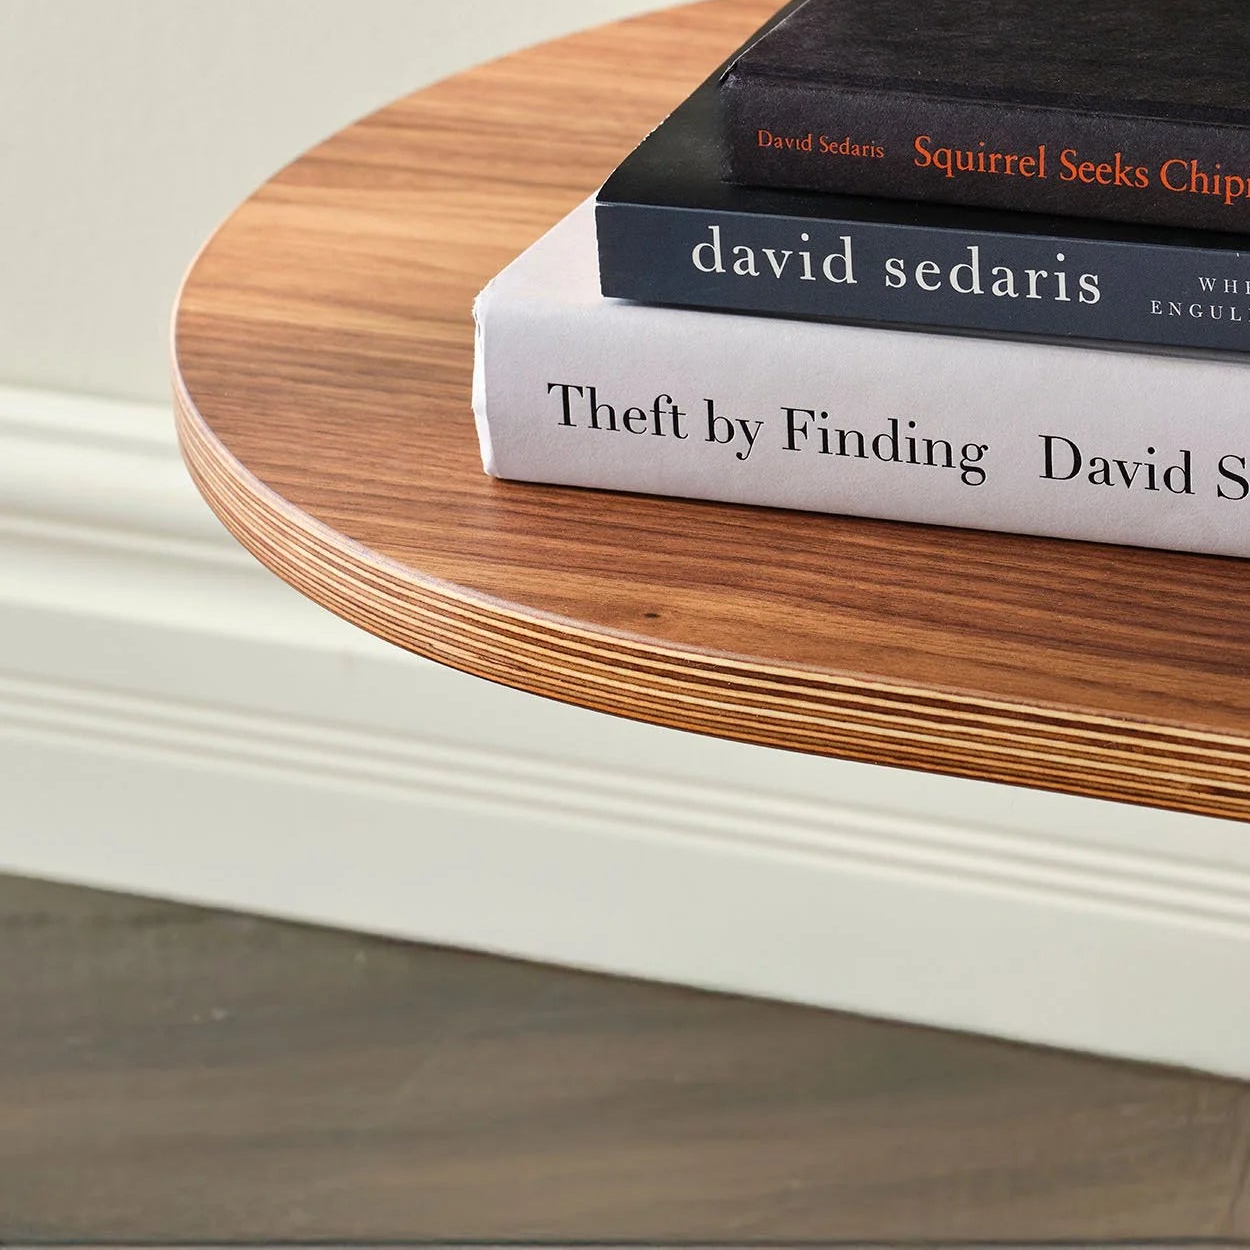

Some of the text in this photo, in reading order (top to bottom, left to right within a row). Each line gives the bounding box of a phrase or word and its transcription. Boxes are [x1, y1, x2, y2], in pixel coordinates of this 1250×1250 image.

[757, 129, 885, 159] David Sedaris
[913, 134, 1046, 179] Squirrel
[1059, 148, 1150, 189] Seeks
[691, 225, 1101, 304] david sedaris
[547, 382, 989, 487] Theft by Finding
[1038, 434, 1196, 495] David
